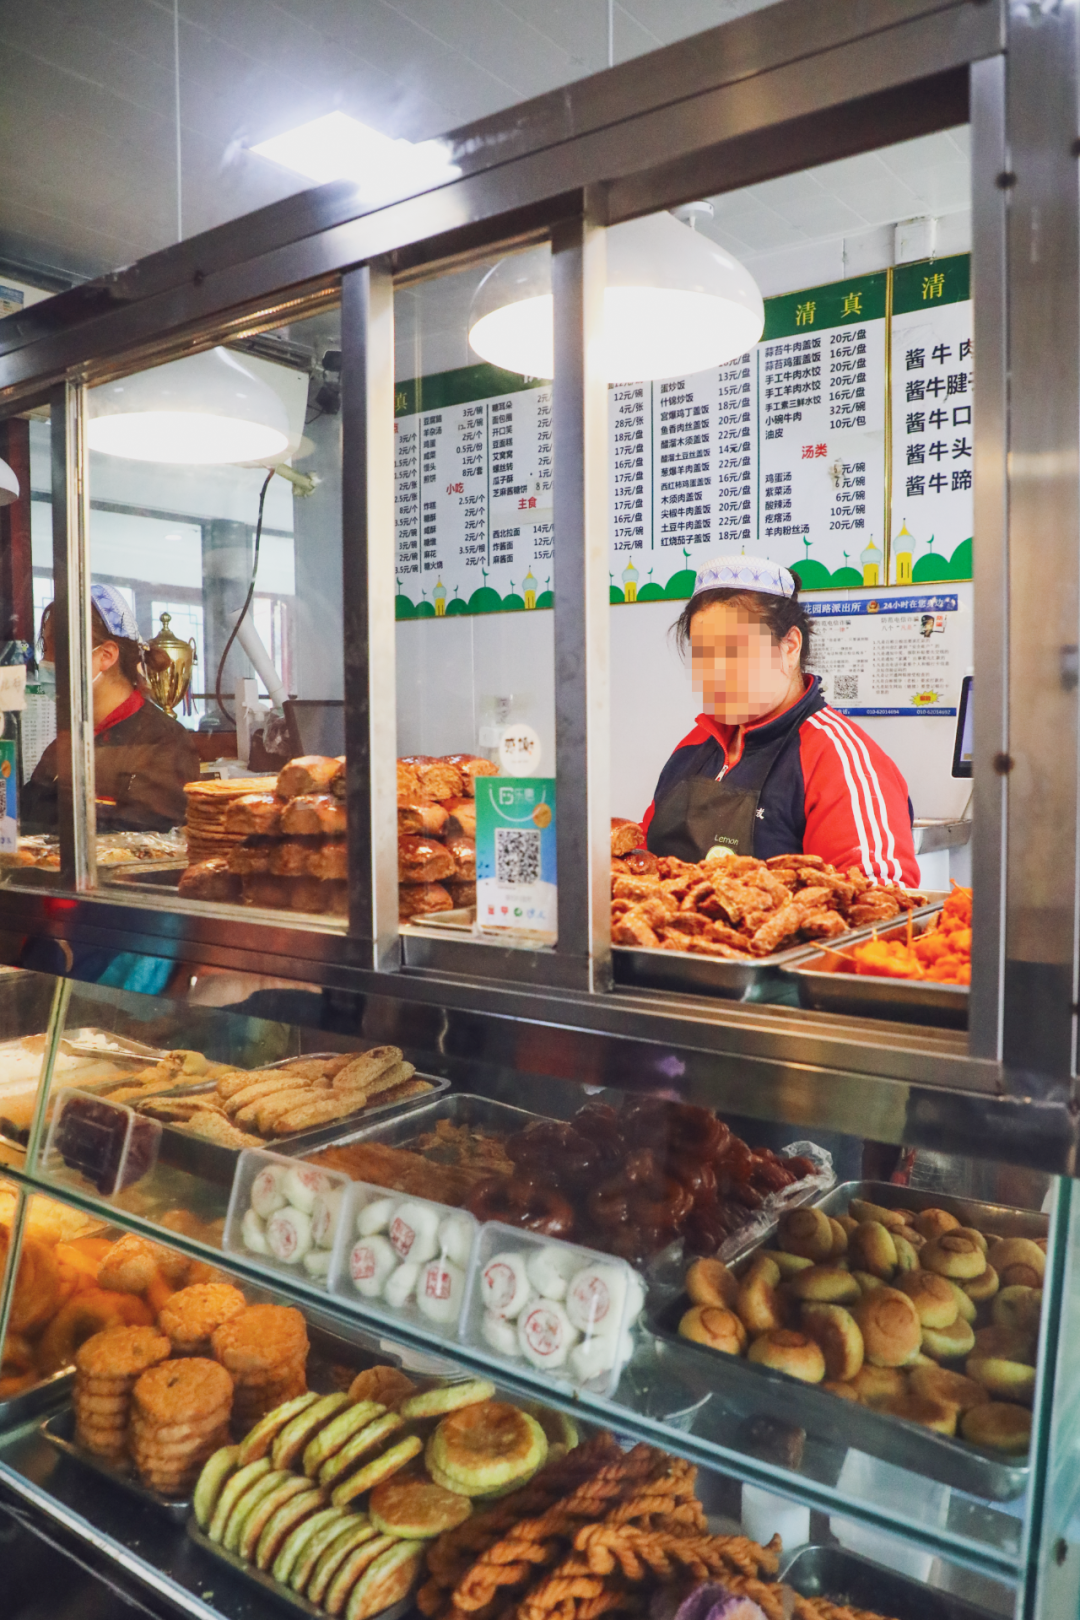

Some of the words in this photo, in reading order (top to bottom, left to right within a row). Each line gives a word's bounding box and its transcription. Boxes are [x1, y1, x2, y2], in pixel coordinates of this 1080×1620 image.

[922, 273, 945, 300] 清
[795, 292, 863, 326] 清真
[830, 329, 867, 345] 20元/盘
[830, 344, 867, 358] 16元/盘
[718, 368, 751, 382] 13元/盘
[765, 366, 821, 385] 手工牛肉水饺
[830, 358, 867, 373] 20元/盘
[765, 380, 821, 399] 手工羊肉水饺
[830, 373, 867, 387] 20元/盘
[614, 389, 643, 401] 12元/碗
[660, 393, 694, 407] 什锦炒饭
[718, 383, 751, 396] 15元/盘
[765, 395, 821, 413] 手工素三鲜水饺
[829, 387, 866, 401] 16元/盘
[619, 402, 643, 414] 4元/张
[718, 397, 751, 411] 18元/盘
[462, 406, 483, 417] 3元/碗
[765, 411, 802, 427] 小碗牛肉
[829, 401, 866, 416] 32元/碗
[615, 416, 644, 428] 28元/张
[660, 419, 709, 435] 鱼香肉丝盖饭
[718, 412, 751, 425] 20元/盘
[765, 429, 784, 440] 油皮
[830, 416, 866, 429] 10元/包
[462, 431, 483, 441] 2元/个
[492, 425, 513, 437] 开口笑
[614, 430, 643, 442] 18元/盘
[718, 426, 751, 440] 22元/盘
[456, 443, 483, 454] 0.5元/份
[615, 444, 644, 455] 17元/盘
[801, 443, 828, 460] 汤类
[462, 455, 483, 465] 1元/个
[615, 458, 643, 469] 16元/盘
[719, 456, 751, 469] 22元/盘
[615, 471, 643, 483] 17元/盘
[660, 477, 712, 491] 西红柿鸡蛋盖饭
[719, 471, 751, 483] 16元/盘
[765, 472, 792, 484] 鸡蛋汤
[446, 483, 464, 495] 小吃
[905, 469, 972, 498] 酱牛蹄
[615, 485, 643, 496] 13元/盘
[660, 491, 703, 505] 木须肉盖饭
[719, 485, 751, 497] 20元/盘
[765, 485, 792, 497] 紫菜汤
[459, 494, 485, 505] 2.5元/个
[518, 497, 537, 510] 主食
[614, 499, 643, 510] 17元/盘
[765, 499, 792, 511] 酸辣汤
[835, 490, 866, 502] 6元/碗
[464, 507, 485, 517] 2元/个
[660, 504, 711, 519] 尖椒牛肉盖饭
[719, 500, 751, 512] 20元/盘
[831, 504, 866, 516] 10元/碗
[464, 519, 485, 529] 2元/个
[614, 513, 643, 523] 16元/盘
[660, 519, 711, 533] 土豆牛肉盖饭
[719, 514, 751, 526] 22元/盘
[493, 527, 520, 539] 西北拉面
[615, 526, 644, 537] 17元/碗
[765, 524, 810, 537] 羊肉粉丝汤
[829, 518, 865, 530] 20元/碗
[464, 532, 485, 542] 2元/个
[660, 533, 711, 547] 红烧茄子盖饭
[719, 529, 751, 541] 18元/盘
[614, 540, 643, 550] 12元/碗
[465, 556, 486, 566] 2元/个
[714, 835, 739, 846] Lemon
